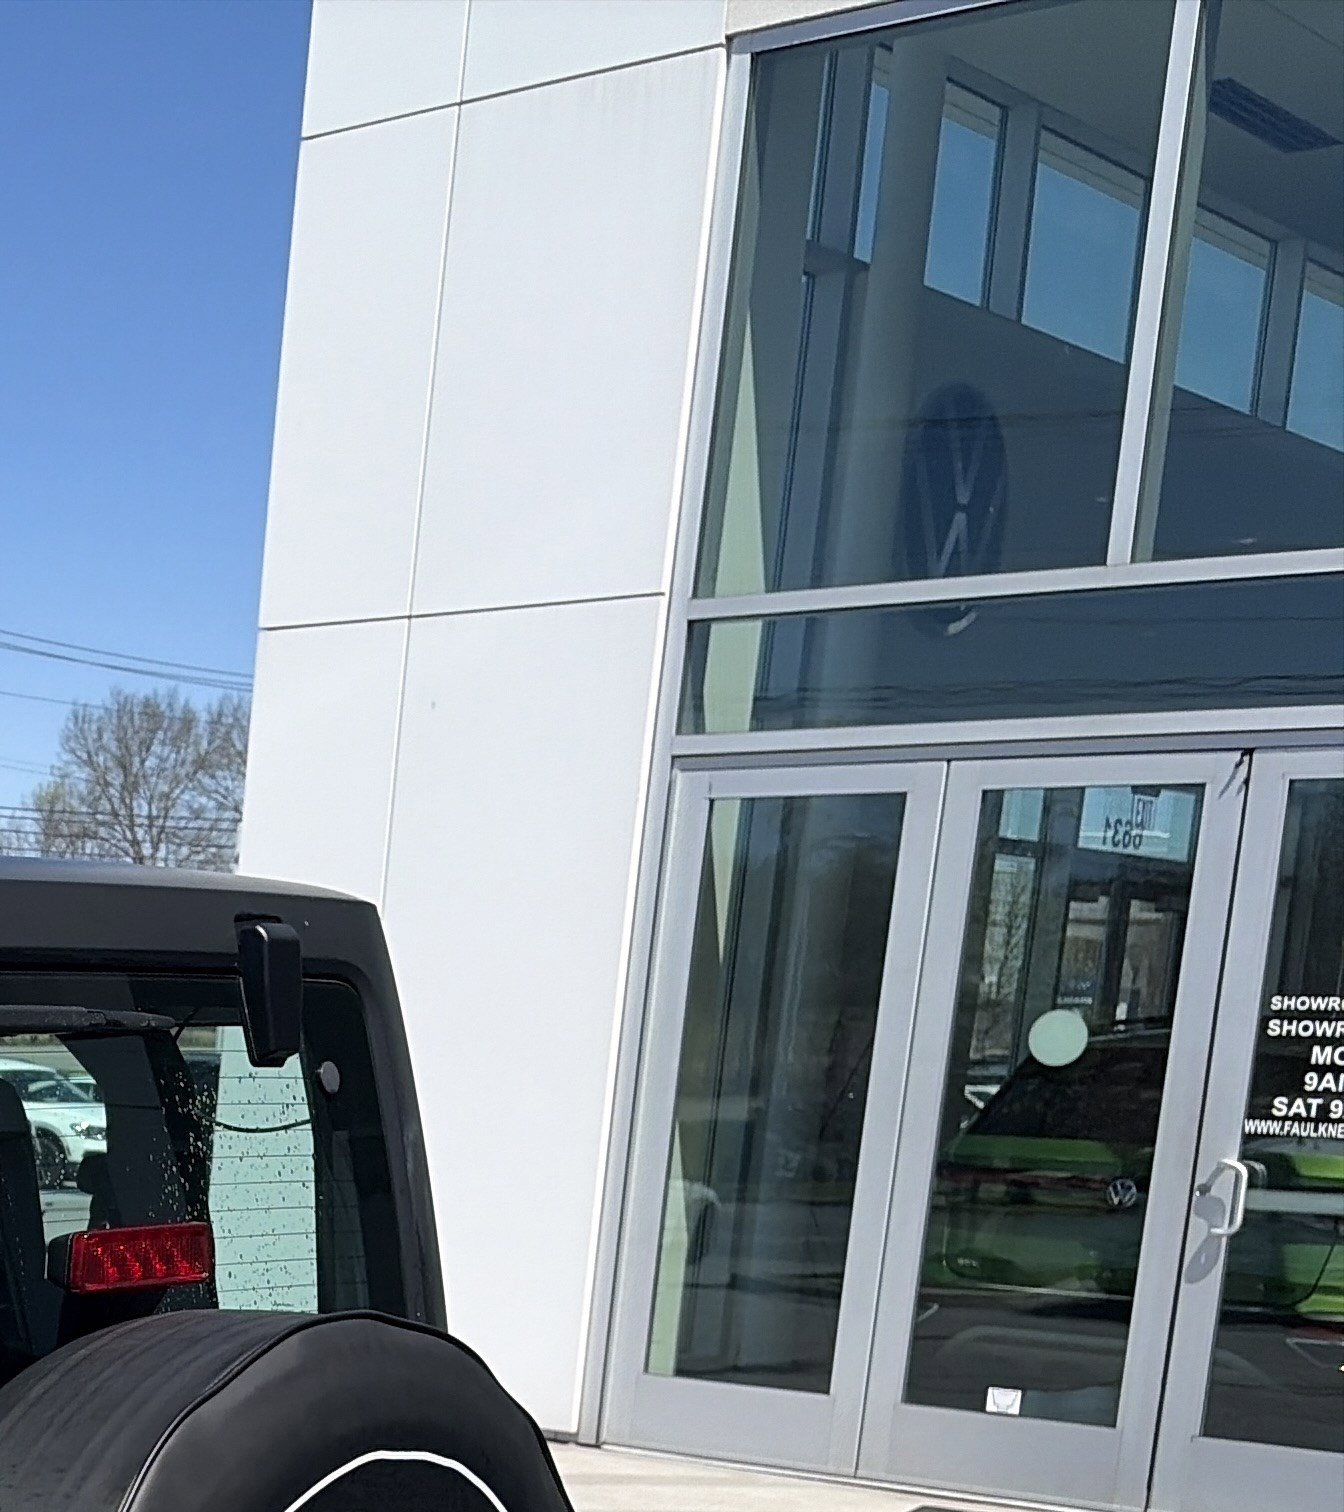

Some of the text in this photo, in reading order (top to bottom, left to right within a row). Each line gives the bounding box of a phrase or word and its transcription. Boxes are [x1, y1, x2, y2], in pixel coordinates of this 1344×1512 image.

[1270, 995, 1344, 1012] SHOWR
[1303, 1071, 1344, 1093] 9A
[1271, 1096, 1324, 1118] SAT
